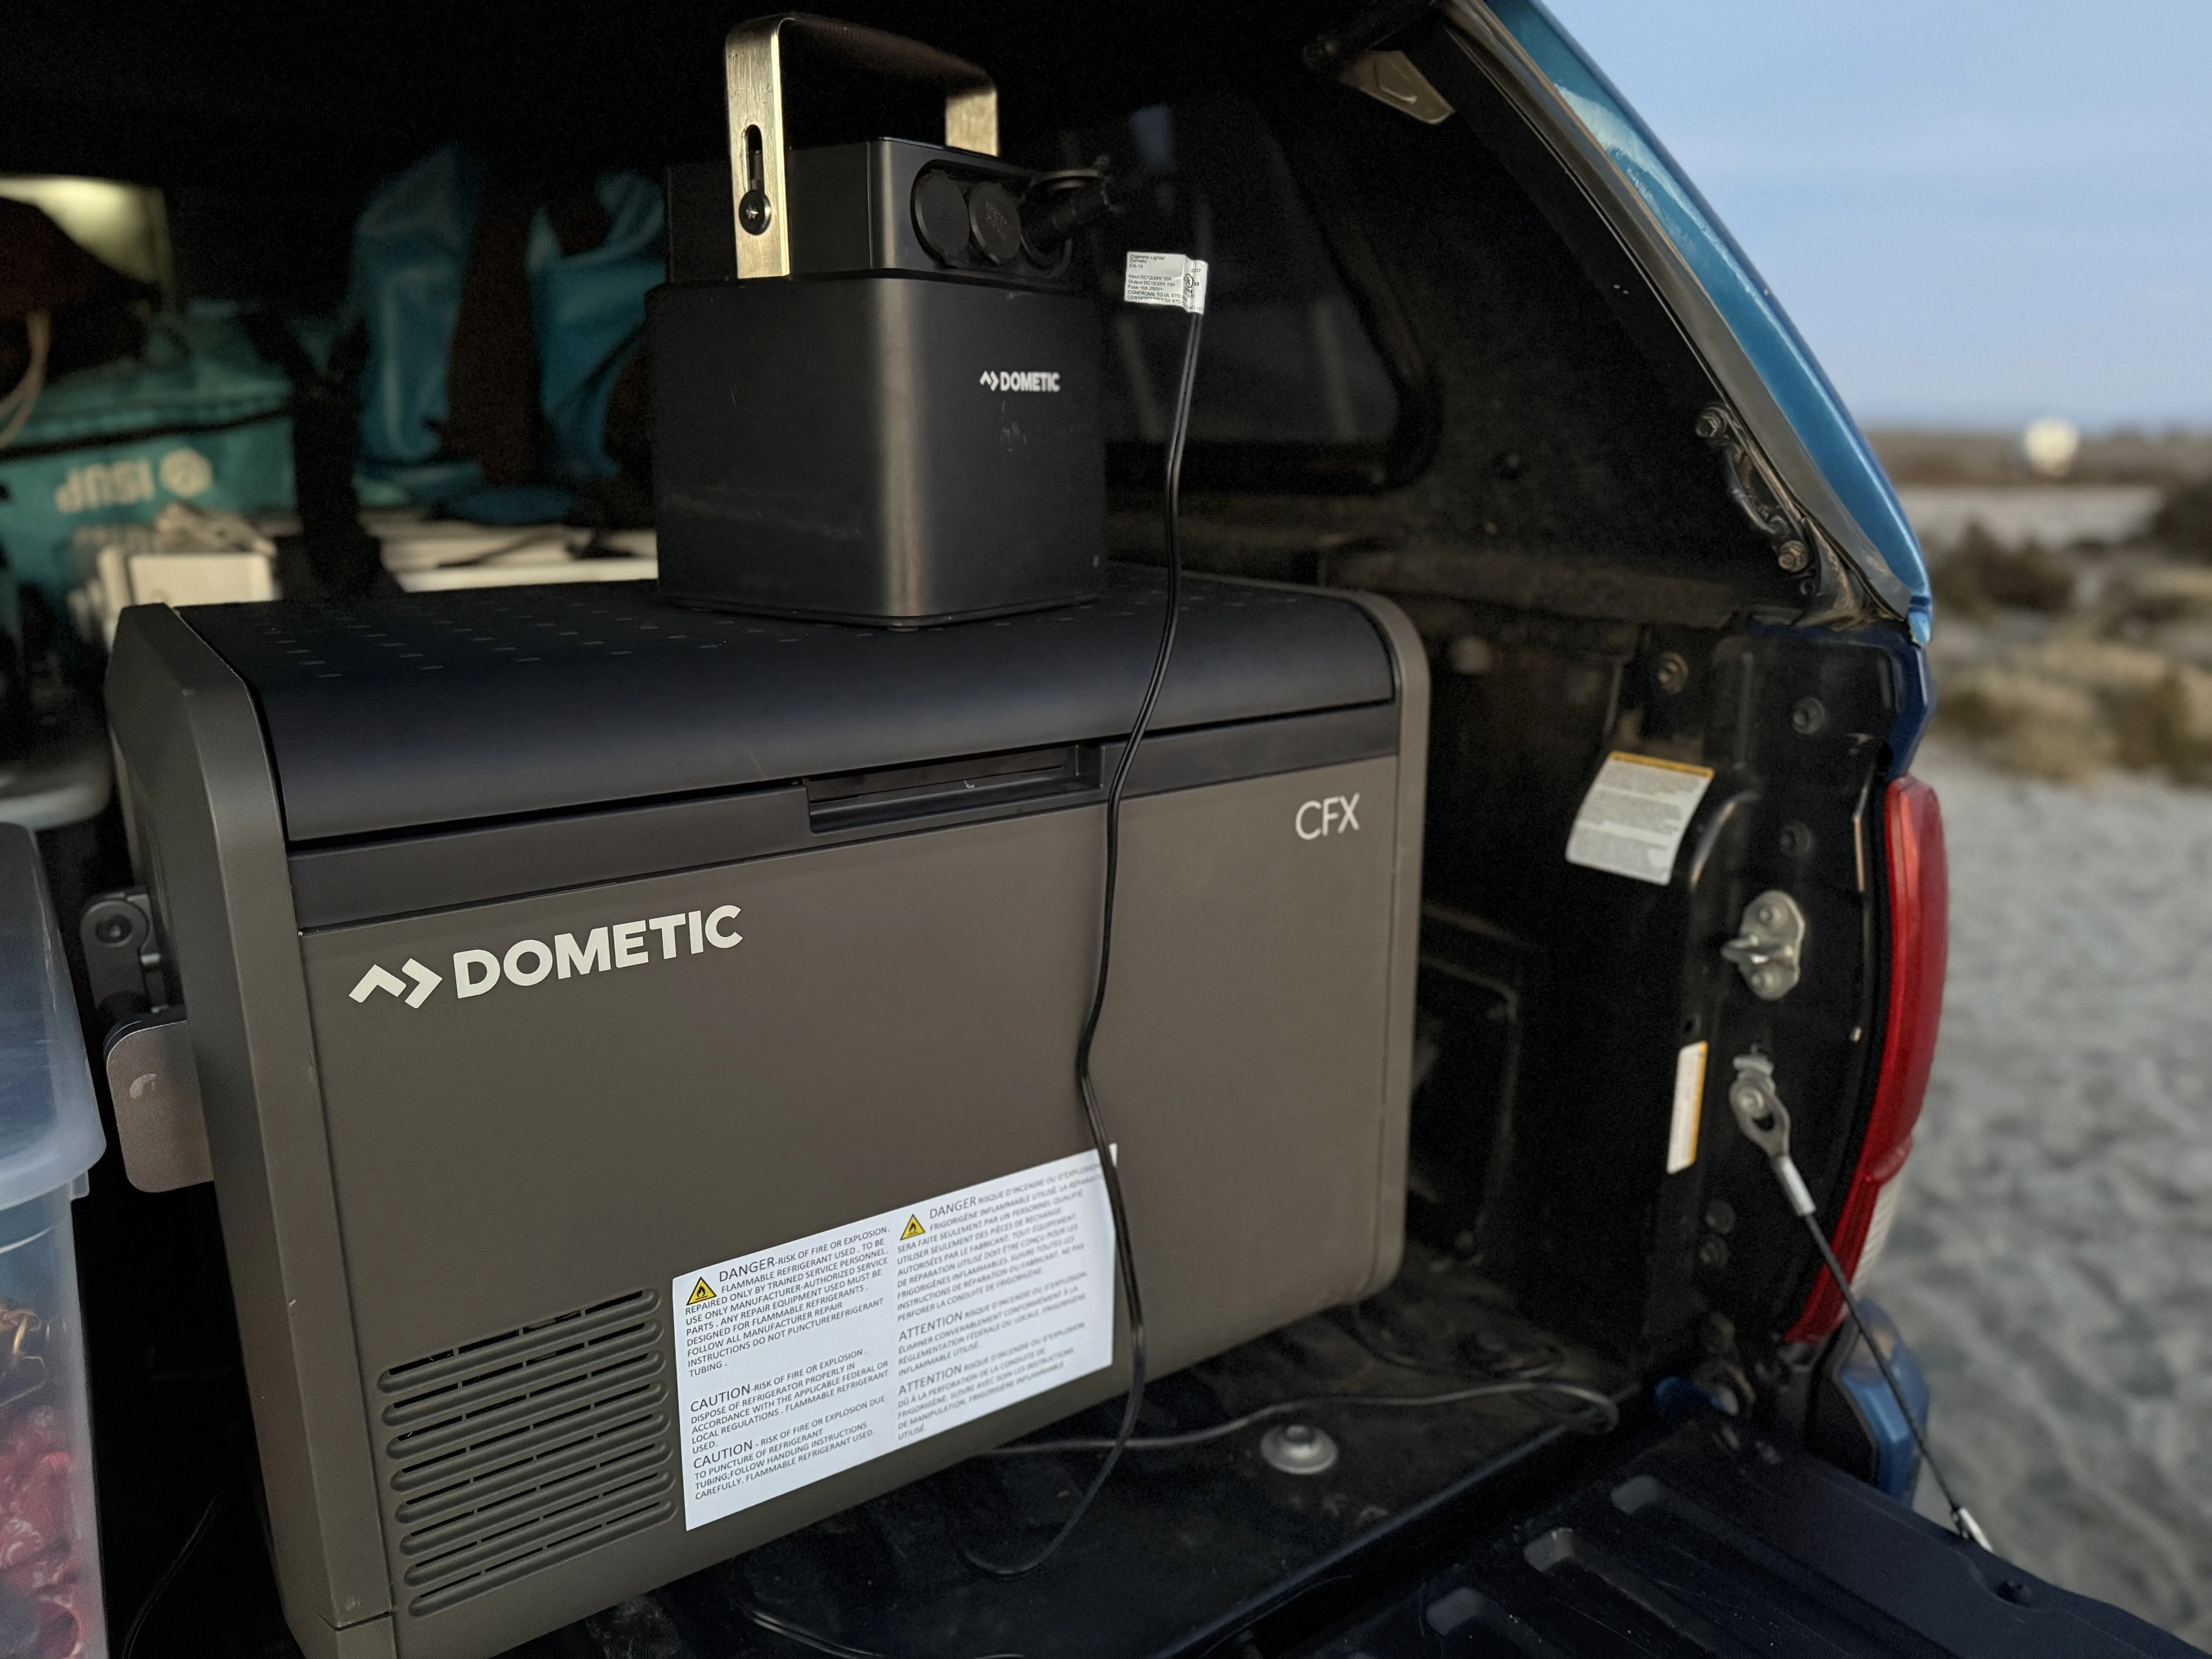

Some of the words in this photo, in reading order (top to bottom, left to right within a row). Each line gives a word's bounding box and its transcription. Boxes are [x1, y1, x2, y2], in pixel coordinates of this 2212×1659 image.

[1000, 371, 1060, 392] DOMETIC
[1295, 792, 1360, 840] CFX
[453, 905, 743, 999] DOMETIC
[929, 1196, 976, 1219] DANGER
[797, 1249, 809, 1259] OF
[811, 1243, 828, 1255] FIRE
[830, 1240, 842, 1249] OR
[897, 1242, 916, 1253] SERA
[918, 1234, 938, 1246] FAITE
[939, 1220, 982, 1240] SEULEMENT
[984, 1216, 998, 1226] PAR
[897, 1249, 929, 1265] UTILISER
[930, 1234, 973, 1254] SEULEMENT
[975, 1230, 988, 1240] DES
[944, 1250, 958, 1261] PAR
[960, 1247, 968, 1256] LE
[721, 1271, 775, 1293] FLAMMABLE
[777, 1254, 832, 1276] REFRIGERANT
[862, 1242, 872, 1251] TO
[874, 1238, 884, 1247] BE
[897, 1278, 907, 1288] DE
[685, 1296, 727, 1315] REPAIRED
[730, 1288, 752, 1301] ONLY
[755, 1284, 765, 1294] BY
[767, 1273, 804, 1290] TRAINED
[805, 1262, 838, 1278] SERVICE
[685, 1314, 702, 1325] USE
[704, 1306, 728, 1319] ONLY
[730, 1267, 855, 1312] MANUFACTURER-AUTHORIZED
[857, 1256, 888, 1273] SERVICE
[720, 1313, 738, 1326] ANY
[740, 1304, 770, 1319] REPAIR
[772, 1287, 822, 1309] EQUIPMENT
[847, 1272, 870, 1286] MUST
[872, 1268, 881, 1278] BE
[897, 1286, 951, 1310] INSTRUCTIONS
[952, 1283, 962, 1292] DE
[687, 1327, 730, 1346] DESIGNED
[733, 1321, 750, 1332] FOR
[752, 1303, 804, 1326] FLAMMABLE
[687, 1339, 724, 1357] FOLLOW
[726, 1334, 741, 1345] ALL
[743, 1311, 812, 1339] MANUFACTURER
[814, 1301, 842, 1316] REPAIR
[688, 1341, 750, 1367] INSTRUCTIONS
[752, 1336, 765, 1346] DO
[768, 1329, 786, 1342] NOT
[787, 1297, 883, 1335] PUNCTUREREFRIGERANT
[897, 1303, 935, 1322] PERFORER
[936, 1300, 946, 1309] LA
[899, 1310, 962, 1342] ATTENTION
[773, 1375, 785, 1384] OF
[787, 1368, 804, 1381] FIRE
[805, 1364, 817, 1374] OR
[819, 1348, 862, 1369] EXPLOSION
[898, 1351, 951, 1377] INFLAMMABLE
[898, 1364, 962, 1396] ATTENTION
[691, 1406, 726, 1424] DISPOSE
[728, 1401, 740, 1411] OF
[742, 1380, 803, 1407] REFRIGERATOR
[805, 1365, 844, 1385] PROPERLY
[847, 1362, 855, 1371] IN
[692, 1408, 750, 1434] ACCORDANCE
[752, 1400, 774, 1413] WITH
[776, 1393, 792, 1405] THE
[794, 1377, 840, 1399] APPLICABLE
[842, 1365, 875, 1382] FEDERAL
[877, 1360, 888, 1369] OR
[692, 1429, 719, 1444] LOCAL
[785, 1388, 834, 1412] FLAMMABLE
[836, 1369, 888, 1394] REFRIGERANT
[917, 1392, 927, 1401] LA
[693, 1439, 752, 1468] CAUTION
[761, 1433, 778, 1446] RISK
[780, 1429, 790, 1439] OF
[793, 1422, 809, 1434] FIRE
[811, 1418, 823, 1427] OR
[825, 1401, 867, 1423] EXPLOSION
[869, 1395, 884, 1406] DUE
[767, 1443, 809, 1464] HANDLING
[811, 1422, 867, 1448] INSTRUCTIONS
[898, 1420, 907, 1429] DE
[694, 1470, 706, 1480] TO
[708, 1453, 754, 1475] PUNCTURE
[755, 1448, 766, 1458] OF
[769, 1428, 823, 1454] REFRIGERANT
[745, 1457, 796, 1482] FLAMMABLE
[798, 1437, 850, 1462] REFRIGERANT
